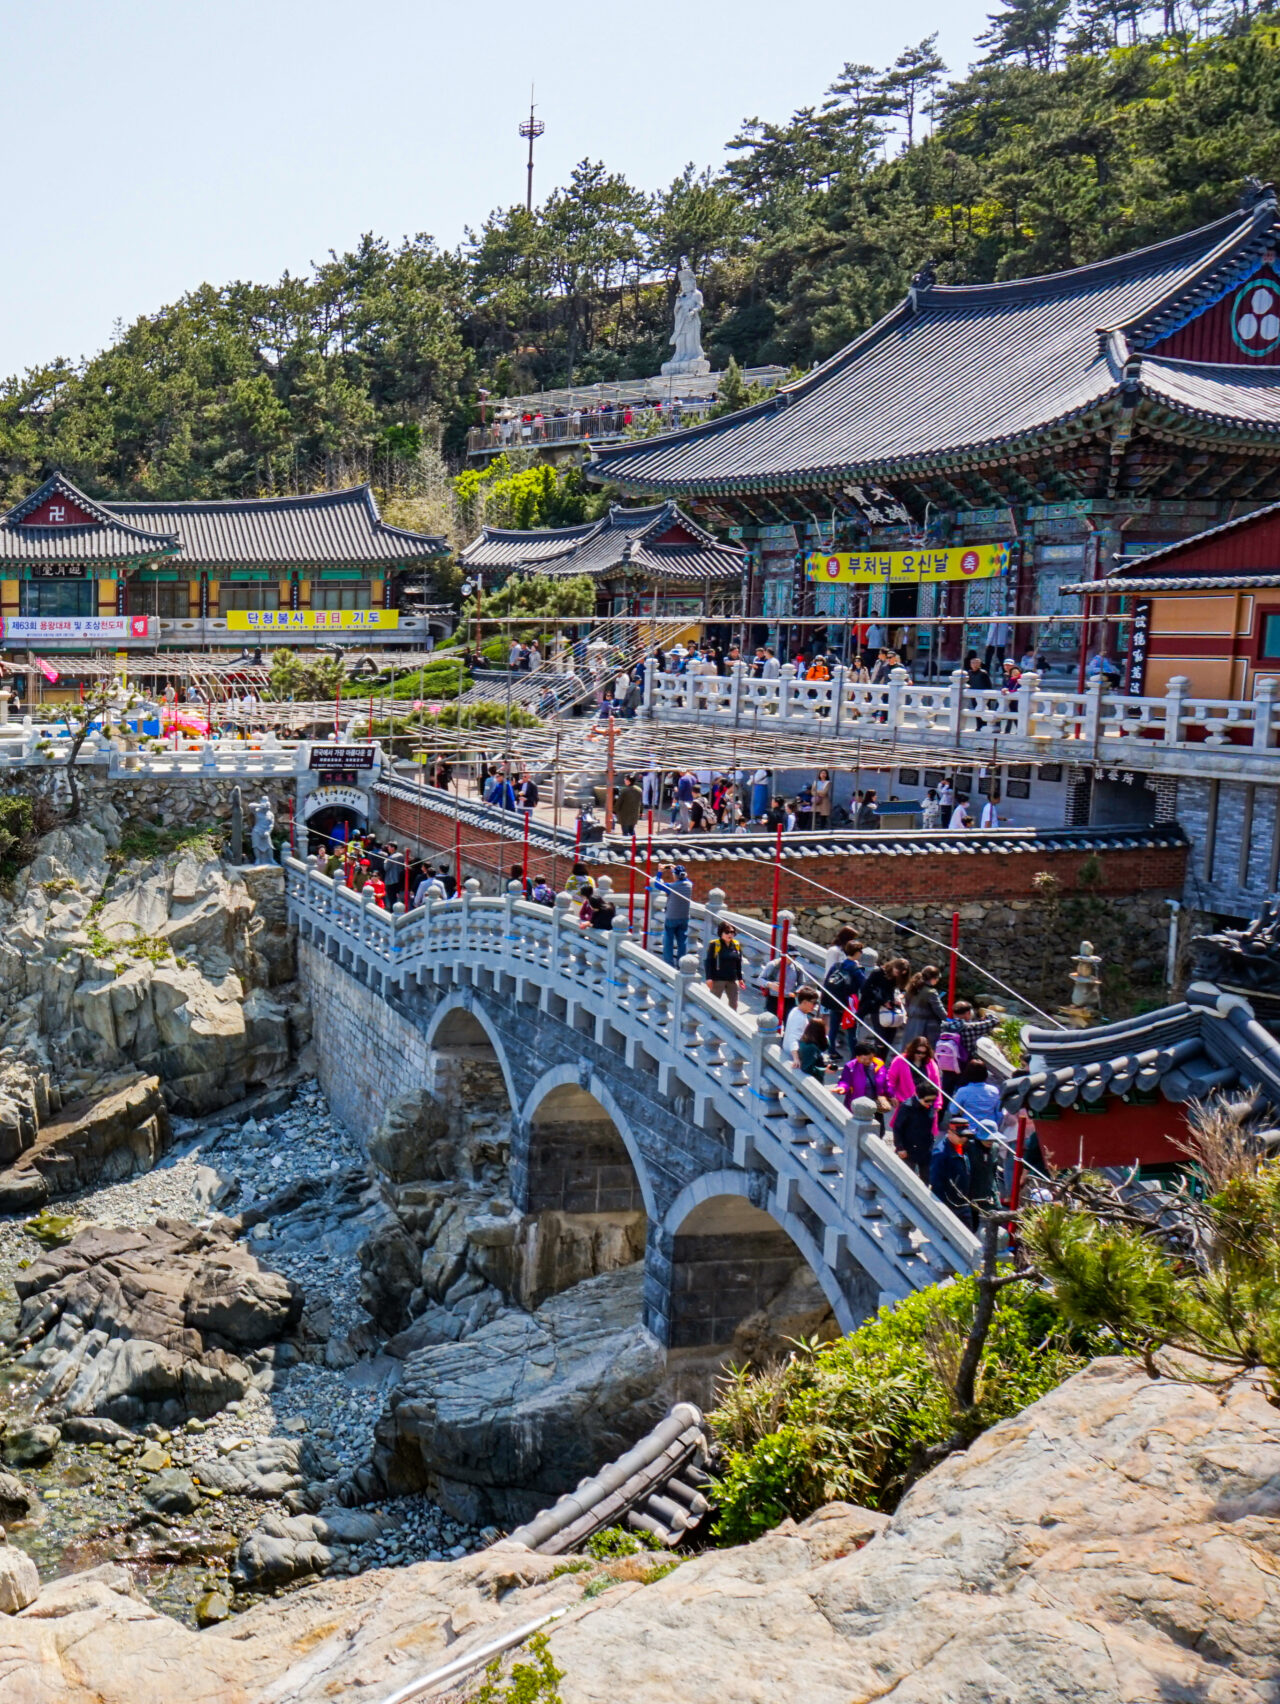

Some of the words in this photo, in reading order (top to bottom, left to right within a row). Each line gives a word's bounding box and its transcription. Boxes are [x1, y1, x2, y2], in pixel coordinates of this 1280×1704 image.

[828, 560, 839, 575] 봉
[847, 556, 892, 576] 부처님
[901, 553, 949, 573] 오신날
[962, 554, 976, 572] 축
[247, 612, 305, 624] 단청불사
[316, 612, 340, 624] 百日
[352, 611, 380, 623] 기도
[12, 620, 37, 630] 제63회
[39, 620, 71, 630] 용왕대재
[74, 620, 82, 629] 및
[134, 620, 145, 633] 행
[313, 748, 334, 757] 한국에서
